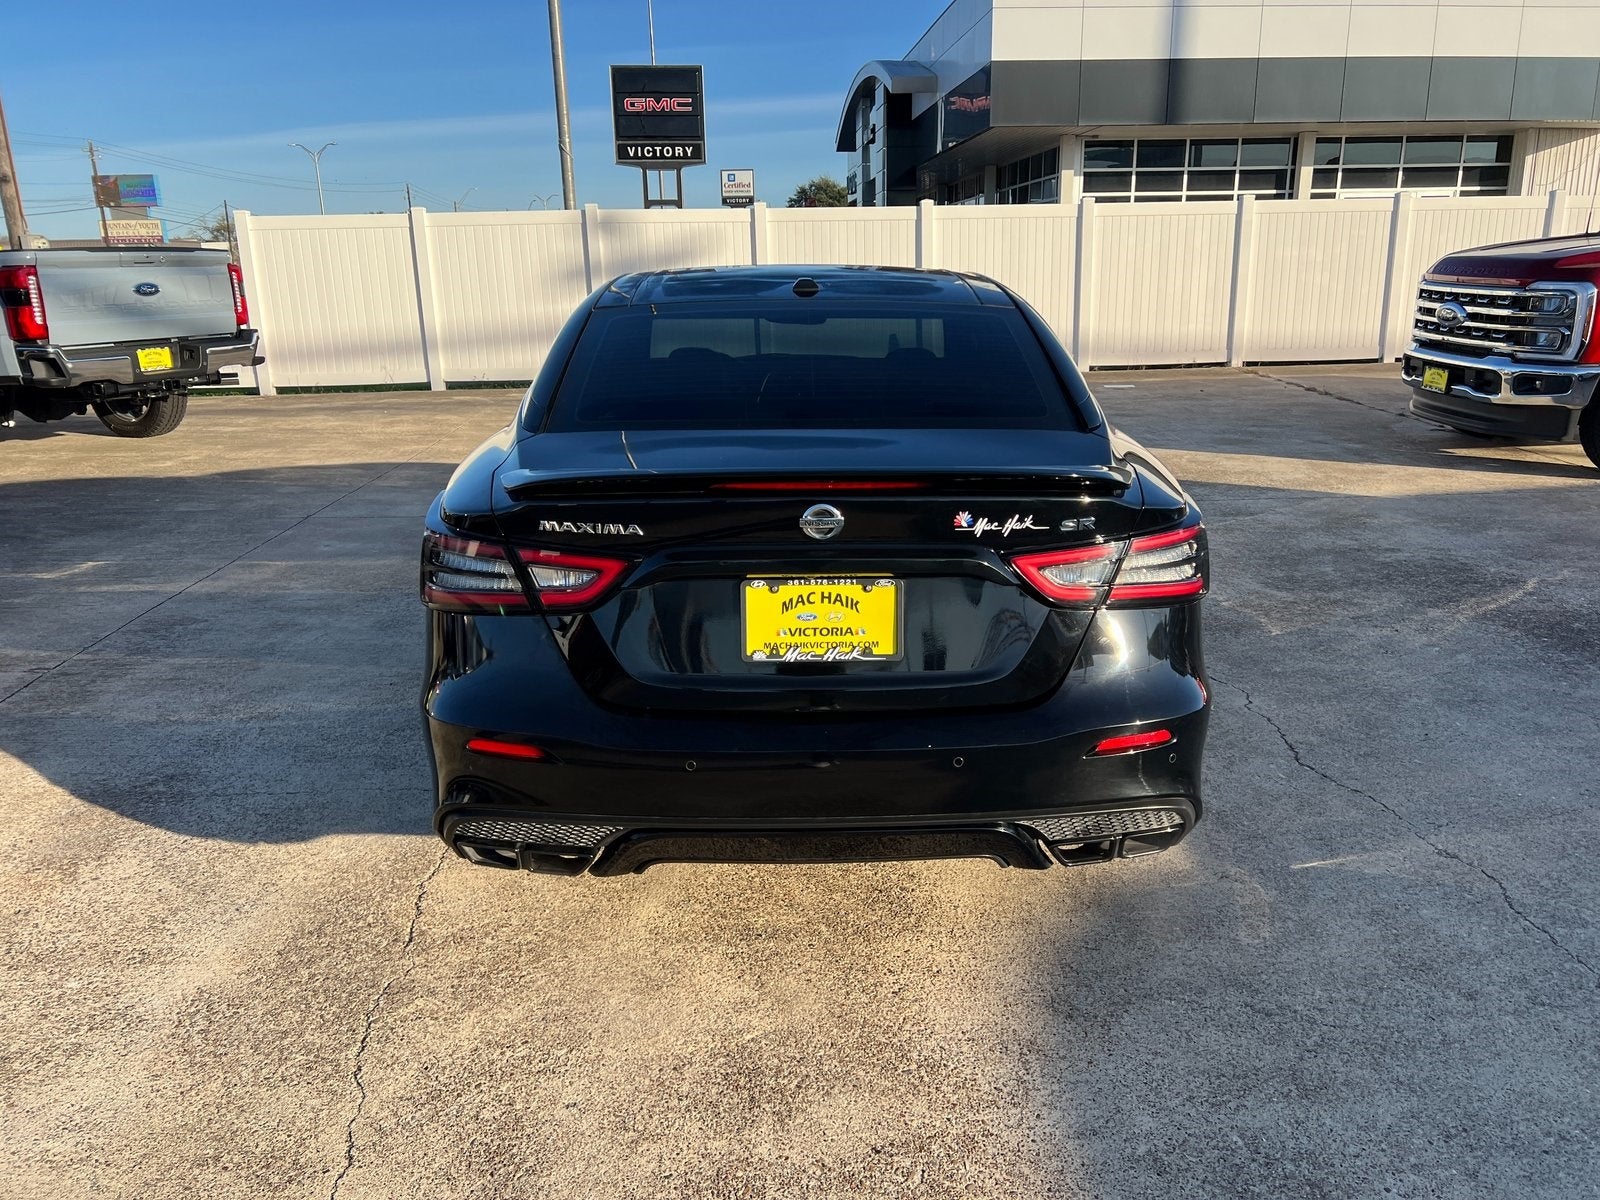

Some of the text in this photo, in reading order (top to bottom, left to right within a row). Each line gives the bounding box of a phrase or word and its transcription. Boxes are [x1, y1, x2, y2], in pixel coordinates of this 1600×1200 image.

[623, 97, 693, 112] GMC
[627, 146, 693, 157] VICTORY
[723, 181, 751, 189] Certified
[539, 520, 644, 536] MAXIMA
[973, 514, 1041, 538] Mac Haik
[1060, 516, 1096, 531] SR
[781, 591, 861, 615] MAC HAIK
[788, 627, 854, 637] VICTORIA
[782, 646, 868, 662] Mac Haik
